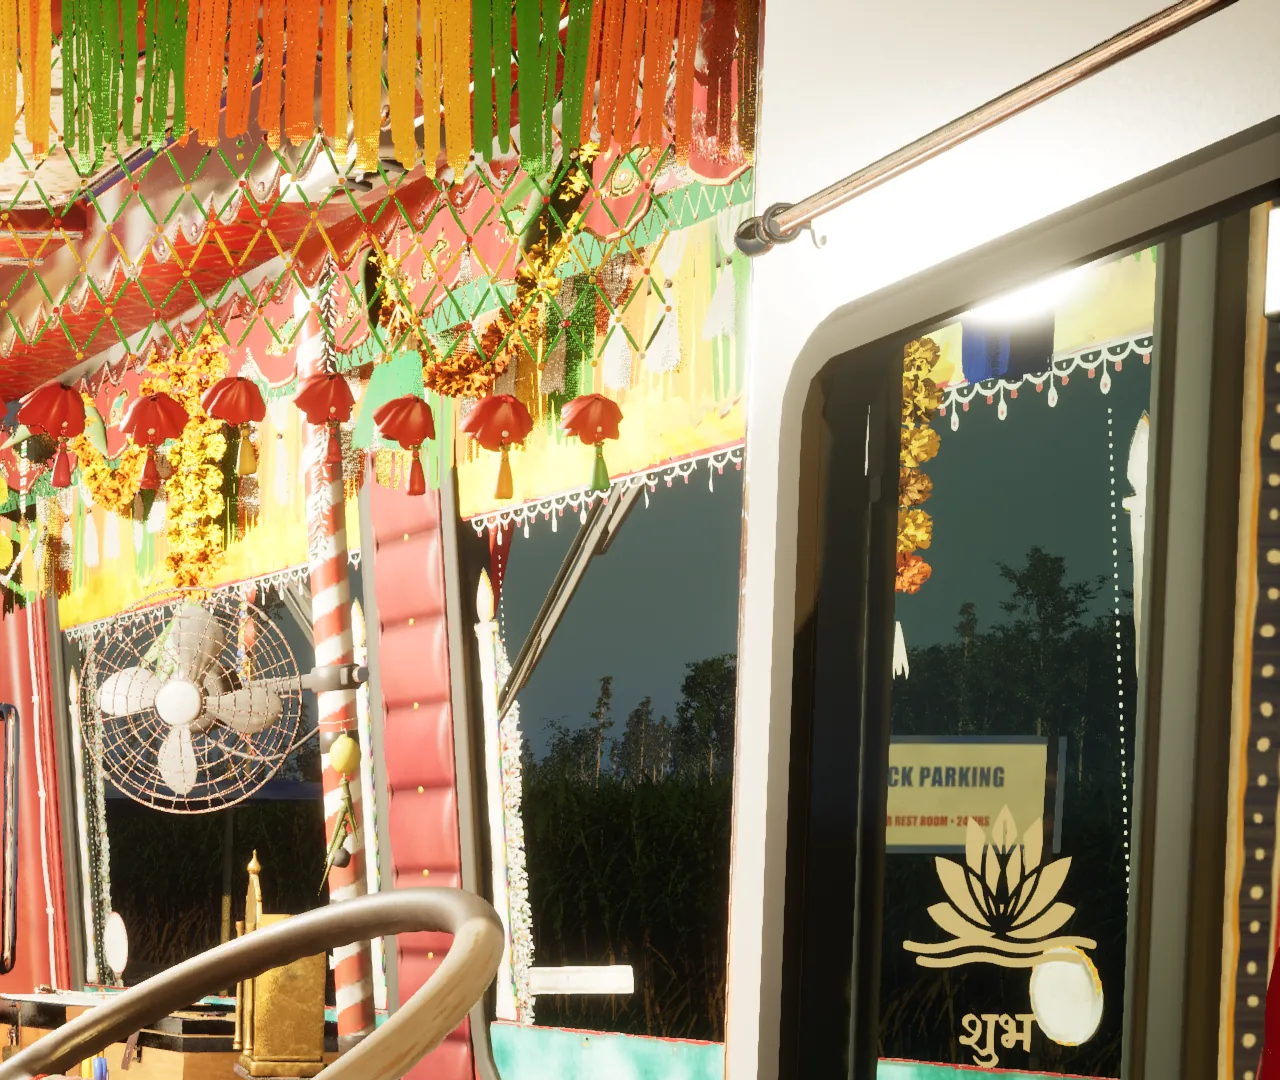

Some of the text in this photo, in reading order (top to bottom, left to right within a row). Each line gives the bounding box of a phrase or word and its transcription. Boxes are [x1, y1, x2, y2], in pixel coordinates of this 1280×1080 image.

[919, 765, 1006, 788] PARKING
[894, 815, 918, 827] REST
[920, 815, 948, 827] ROOM
[958, 1012, 1037, 1069] शुभ
